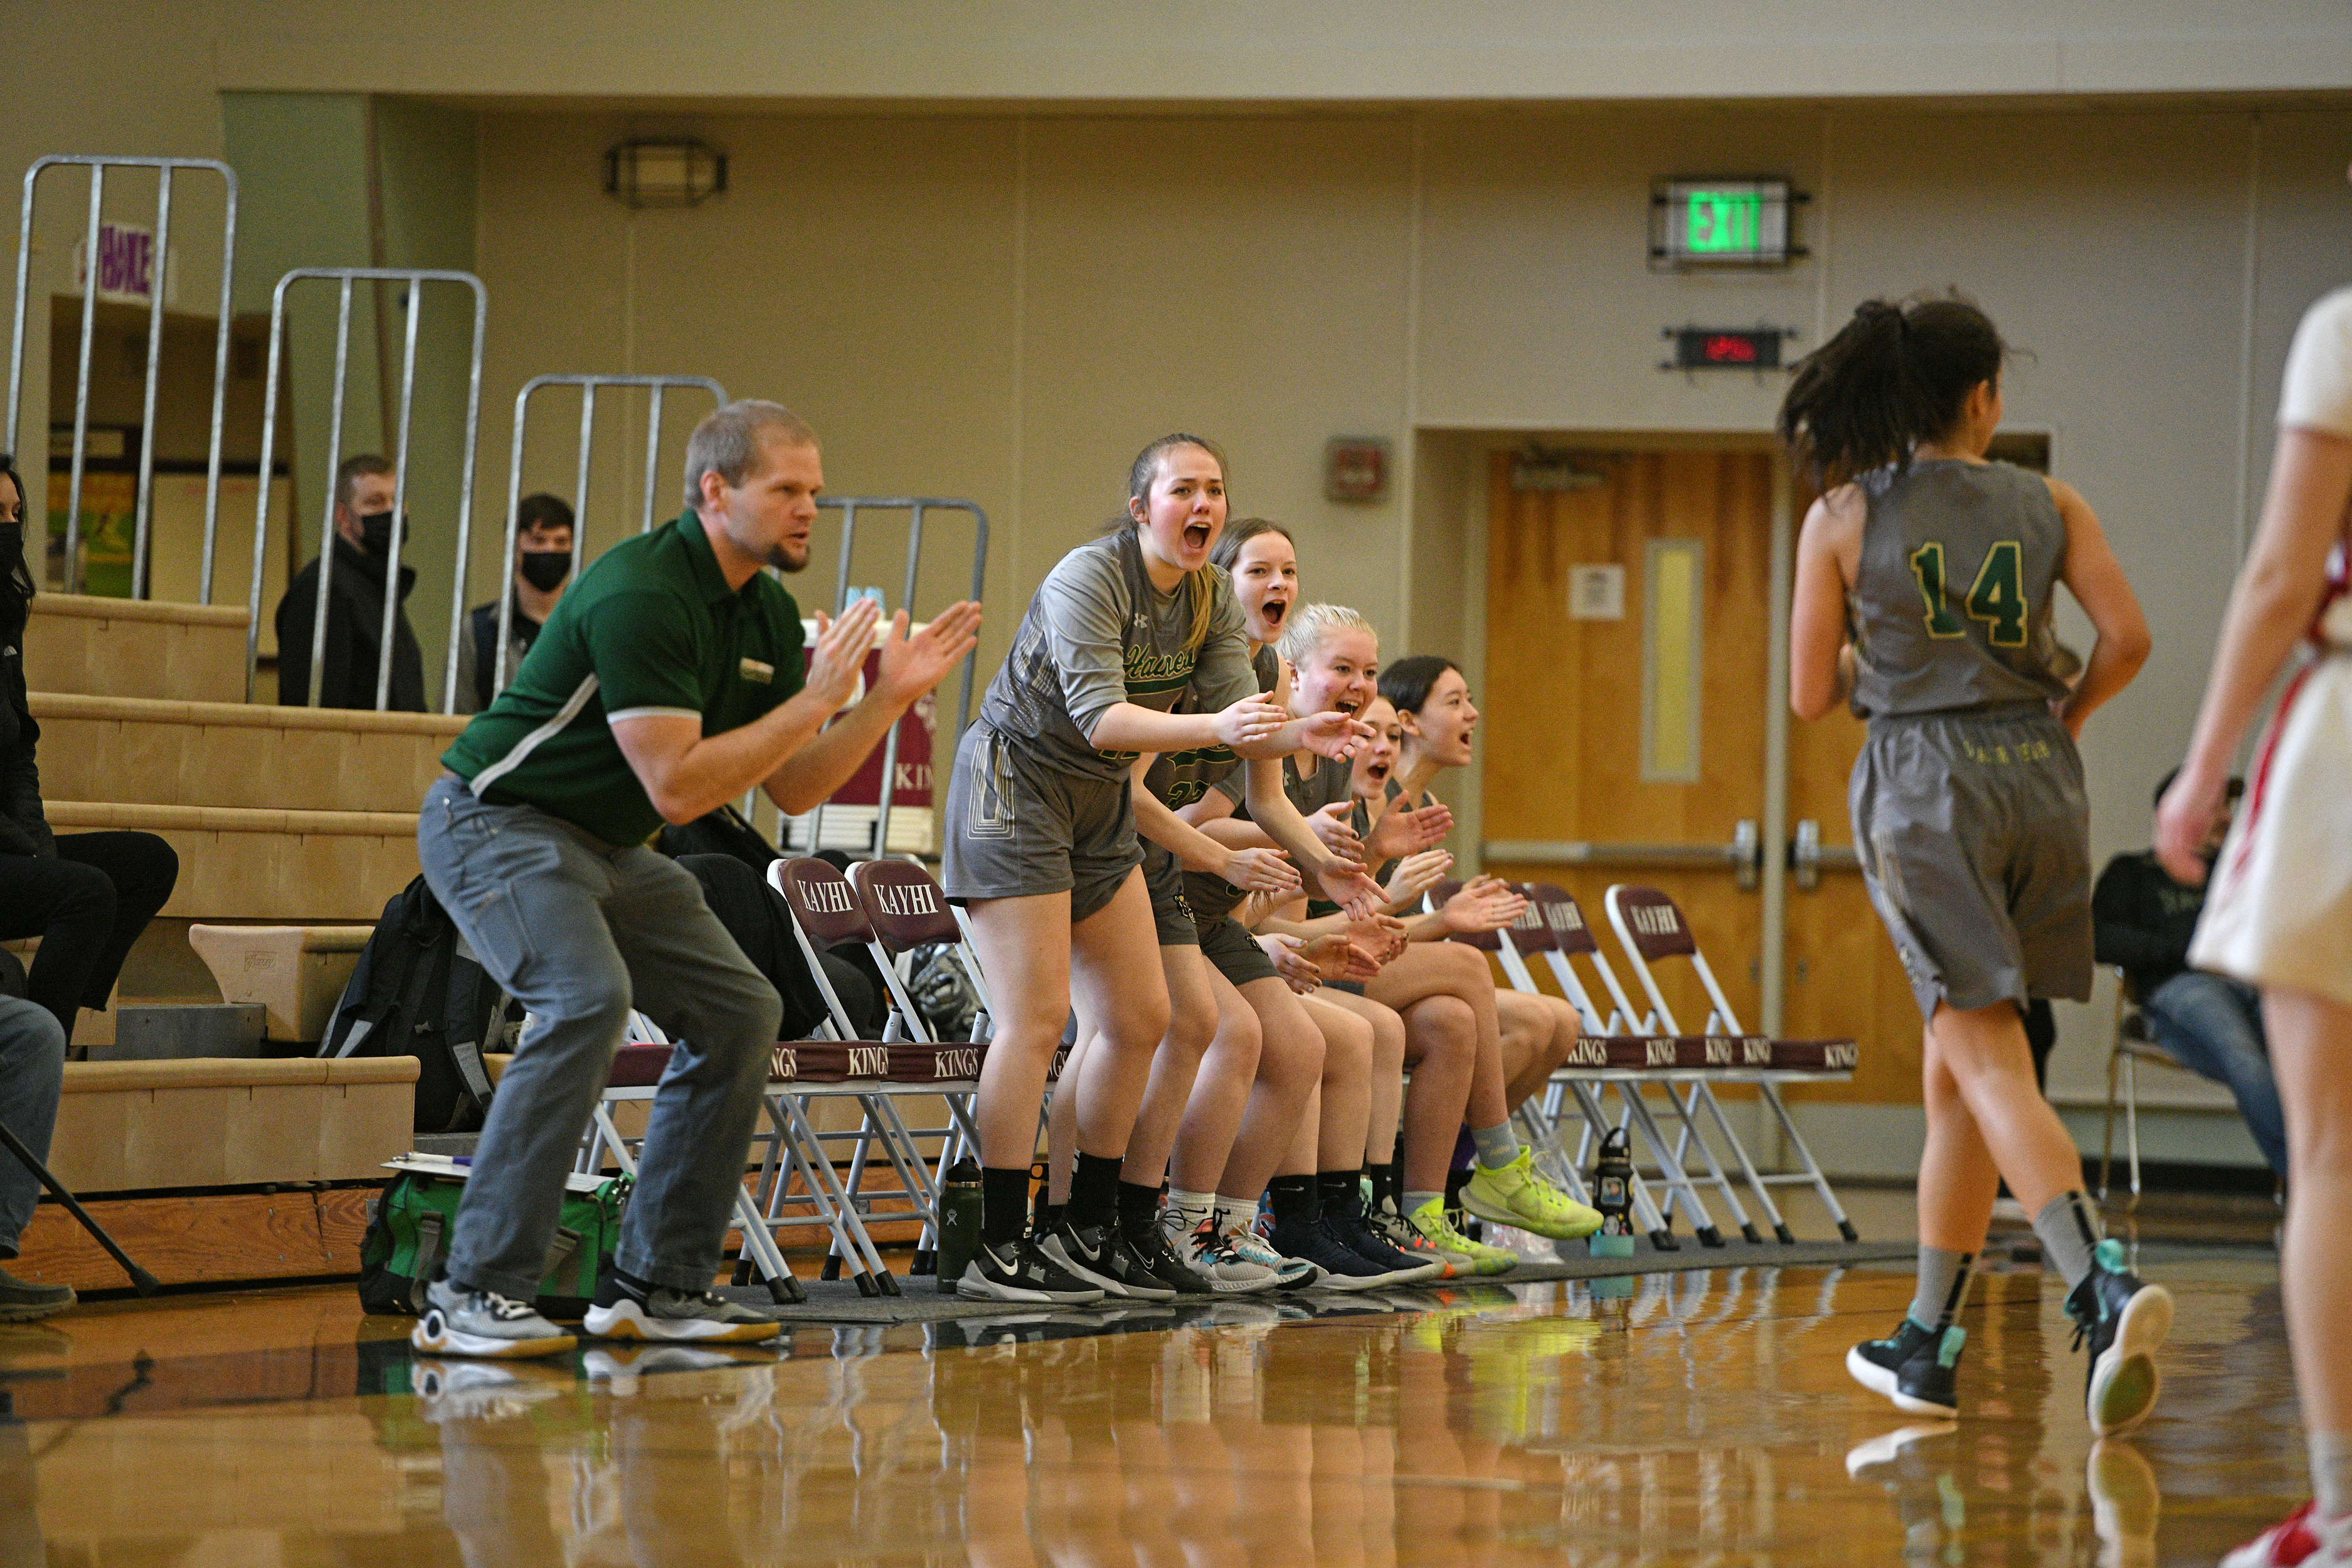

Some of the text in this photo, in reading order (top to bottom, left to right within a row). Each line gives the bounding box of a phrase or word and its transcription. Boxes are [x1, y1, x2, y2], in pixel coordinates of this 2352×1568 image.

[1688, 191, 1762, 252] EXIT
[1910, 541, 2027, 647] 14
[896, 763, 934, 790] KIN
[797, 879, 854, 913] KAYHI
[873, 884, 939, 915] KAYHI
[1630, 905, 1680, 935] KAYHI
[768, 1047, 797, 1077] NGS
[847, 1046, 888, 1076] KINGS
[934, 1048, 978, 1078] KINGS
